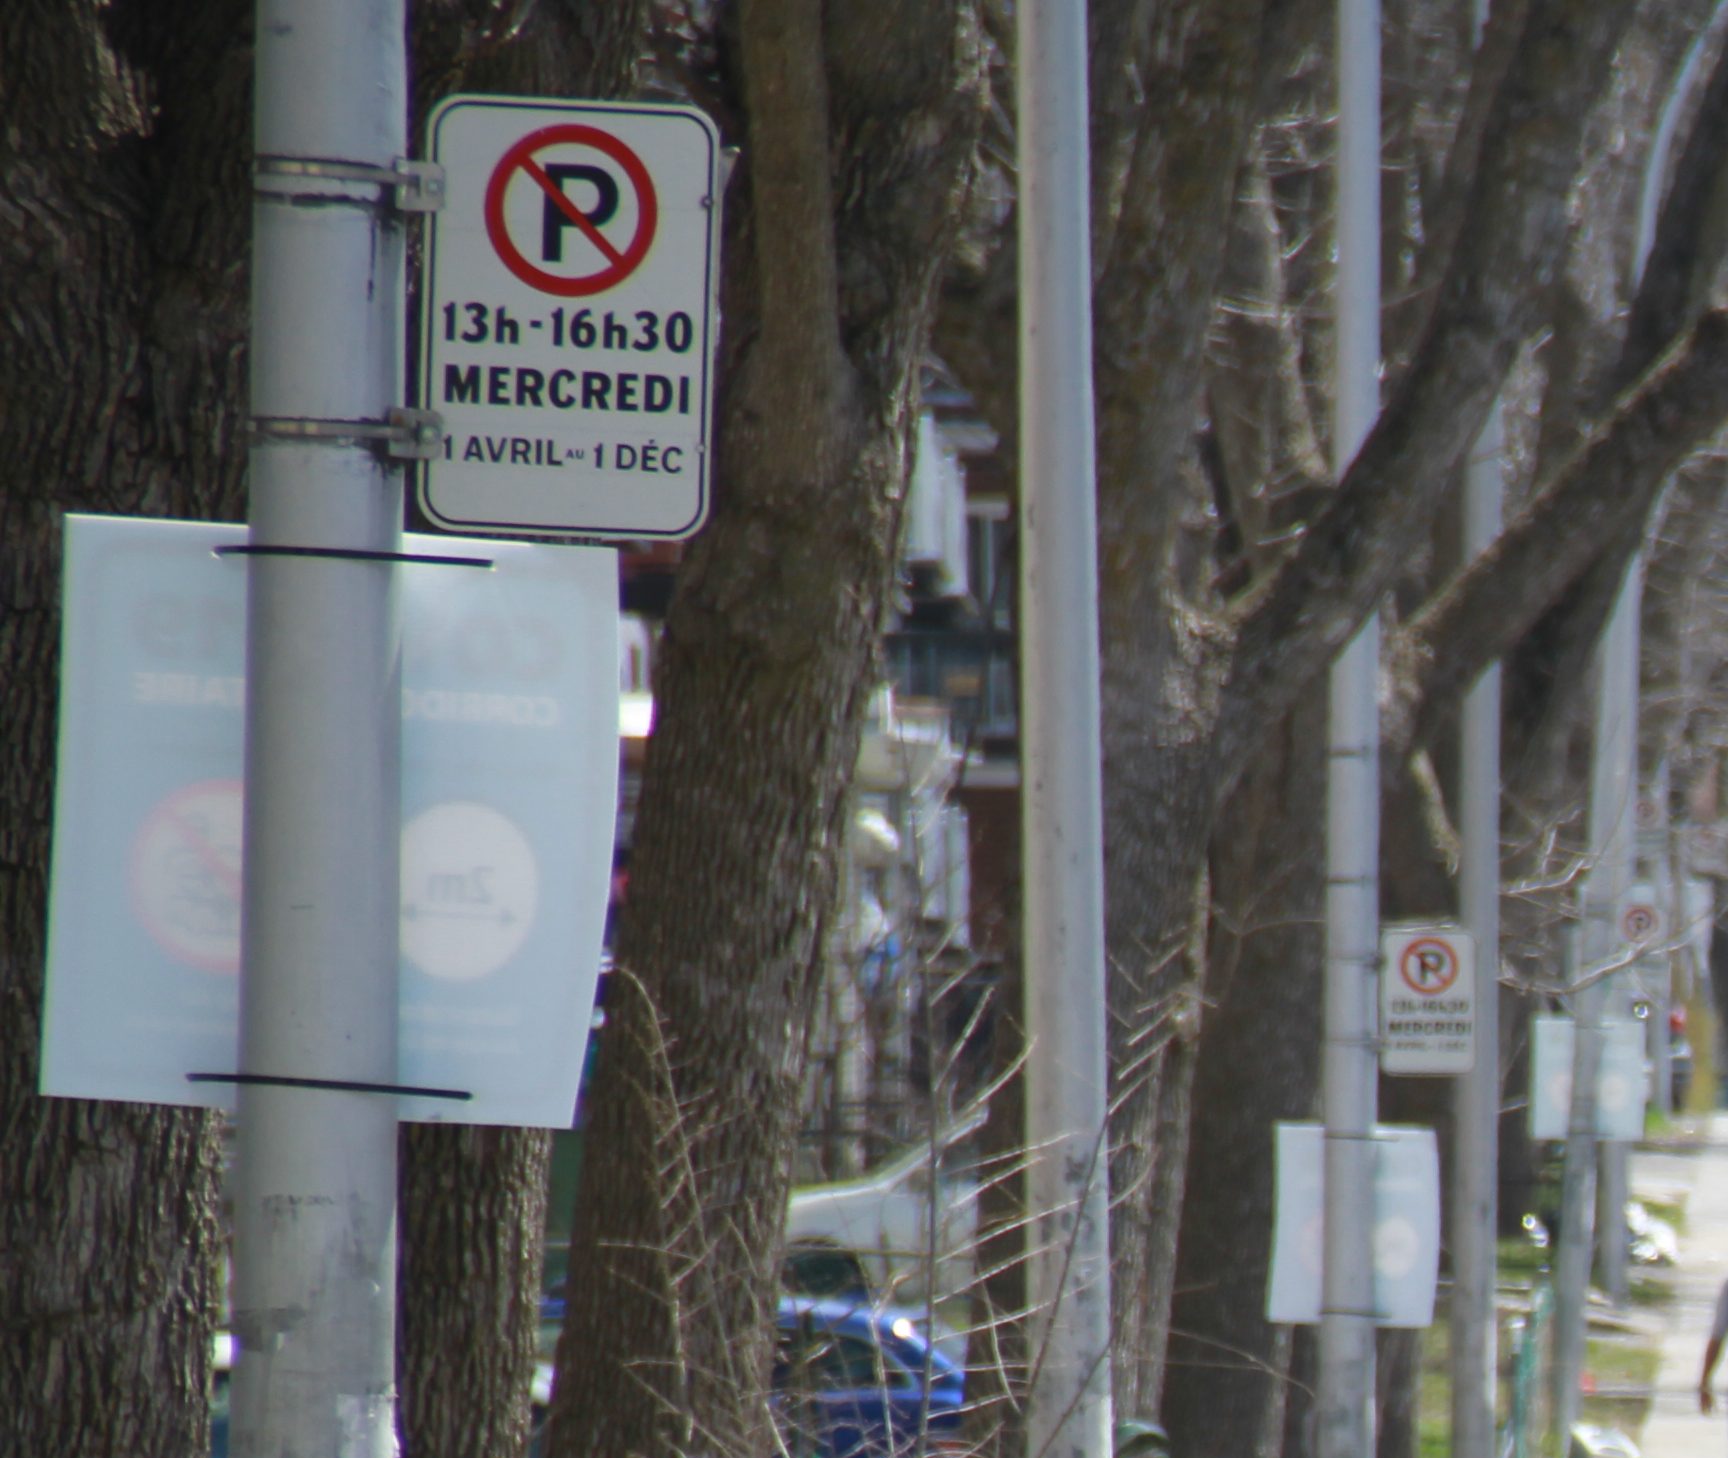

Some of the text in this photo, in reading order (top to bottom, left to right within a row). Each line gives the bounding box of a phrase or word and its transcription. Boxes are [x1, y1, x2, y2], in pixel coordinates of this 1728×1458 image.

[444, 363, 690, 415] MERCREDI
[443, 434, 683, 474] 1 AVRIL AU 1 DÉC
